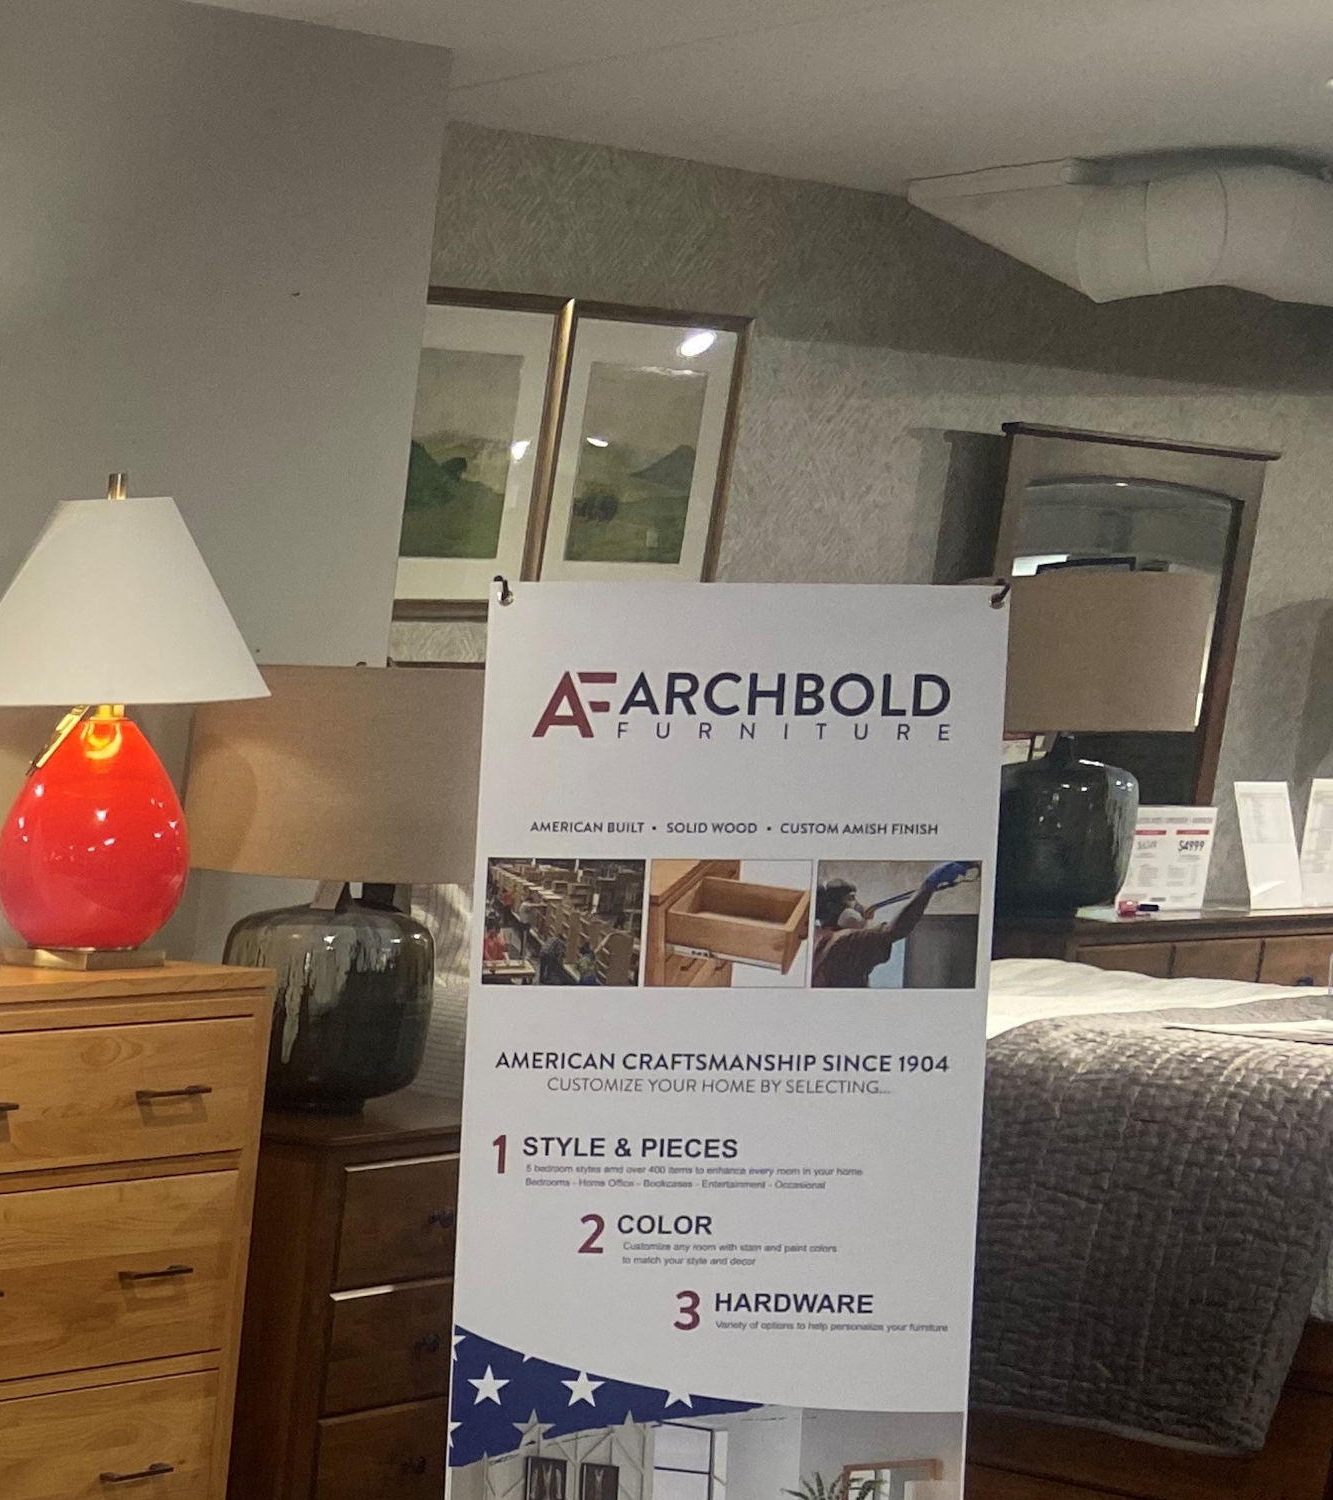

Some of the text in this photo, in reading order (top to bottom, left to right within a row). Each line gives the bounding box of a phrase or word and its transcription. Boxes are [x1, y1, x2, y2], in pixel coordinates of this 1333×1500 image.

[619, 672, 951, 717] ARCHBOLD
[617, 722, 951, 742] FURNITURE
[530, 821, 939, 836] AMERICAN BUILT SOLID WOOD CUSTOM AMISH FINISH
[495, 1052, 949, 1074] AMERICAN CRAFTSMANSHIP SINCE 1904
[547, 1077, 643, 1093] CUSTOMIZE
[646, 1077, 697, 1094] YOUR
[701, 1078, 755, 1094] HOME
[759, 1078, 782, 1094] BY
[492, 1135, 739, 1174] 1 STYLE & PIECES
[534, 1165, 573, 1174] bedroom
[575, 1165, 601, 1175] styles
[649, 1166, 666, 1174] 400
[668, 1166, 693, 1174] items
[707, 1167, 746, 1175] enhance
[803, 1167, 811, 1176] in
[814, 1169, 834, 1177] your
[836, 1168, 863, 1176] home
[525, 1178, 570, 1187] Bedrooms
[579, 1179, 605, 1187] Home
[608, 1179, 634, 1187] Office
[643, 1179, 693, 1188] Bookcases
[702, 1180, 766, 1189] Entertainment
[775, 1181, 826, 1189] Occasional
[577, 1214, 713, 1254] 2 COLOR
[623, 1242, 671, 1251] Customize
[673, 1244, 690, 1252] any
[719, 1243, 737, 1251] with
[739, 1244, 762, 1252] stain
[764, 1244, 782, 1252] and
[784, 1244, 807, 1254] paint
[809, 1244, 837, 1253] colors
[622, 1256, 756, 1267] to match your style and decor
[673, 1290, 874, 1331] 3 HARDWARE
[715, 1321, 948, 1333] Variety of options to help personalize your furniture
